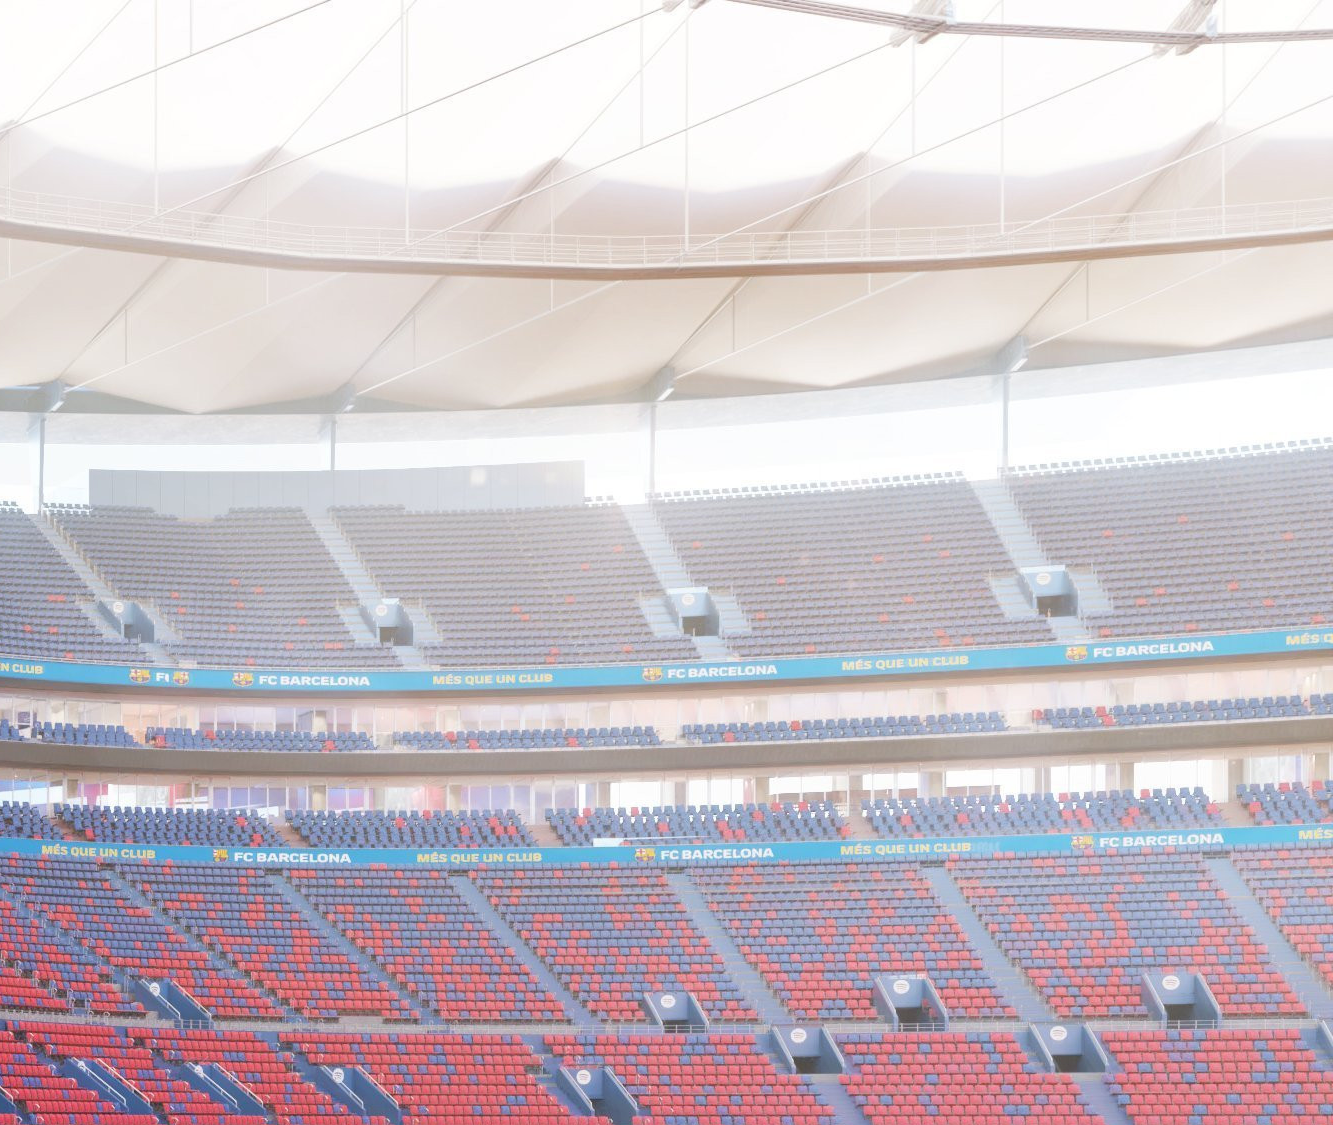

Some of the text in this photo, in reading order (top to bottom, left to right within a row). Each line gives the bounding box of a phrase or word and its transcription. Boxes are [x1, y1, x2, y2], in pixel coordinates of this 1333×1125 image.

[1285, 632, 1320, 646] MÉS
[1093, 641, 1214, 658] FC BARCELONA
[12, 663, 44, 675] CLUB
[842, 655, 969, 671] MÉS QUE UN CLUB
[667, 664, 778, 679] FC BARCELONA
[259, 675, 370, 686] FC BARCELONA
[432, 673, 553, 686] MÉS QUE UN CLUB
[1099, 833, 1224, 848] FC BARCELONA
[42, 844, 156, 859] MÉS QUE UN CLUB
[661, 848, 774, 860] FC BARCELONA
[840, 843, 871, 856] MÉS
[875, 844, 906, 855] QUE
[908, 843, 930, 854] UN
[933, 842, 971, 852] CLUB
[234, 852, 351, 863] FC BARCELONA
[417, 851, 542, 864] MÉS QUE UN CLUB
